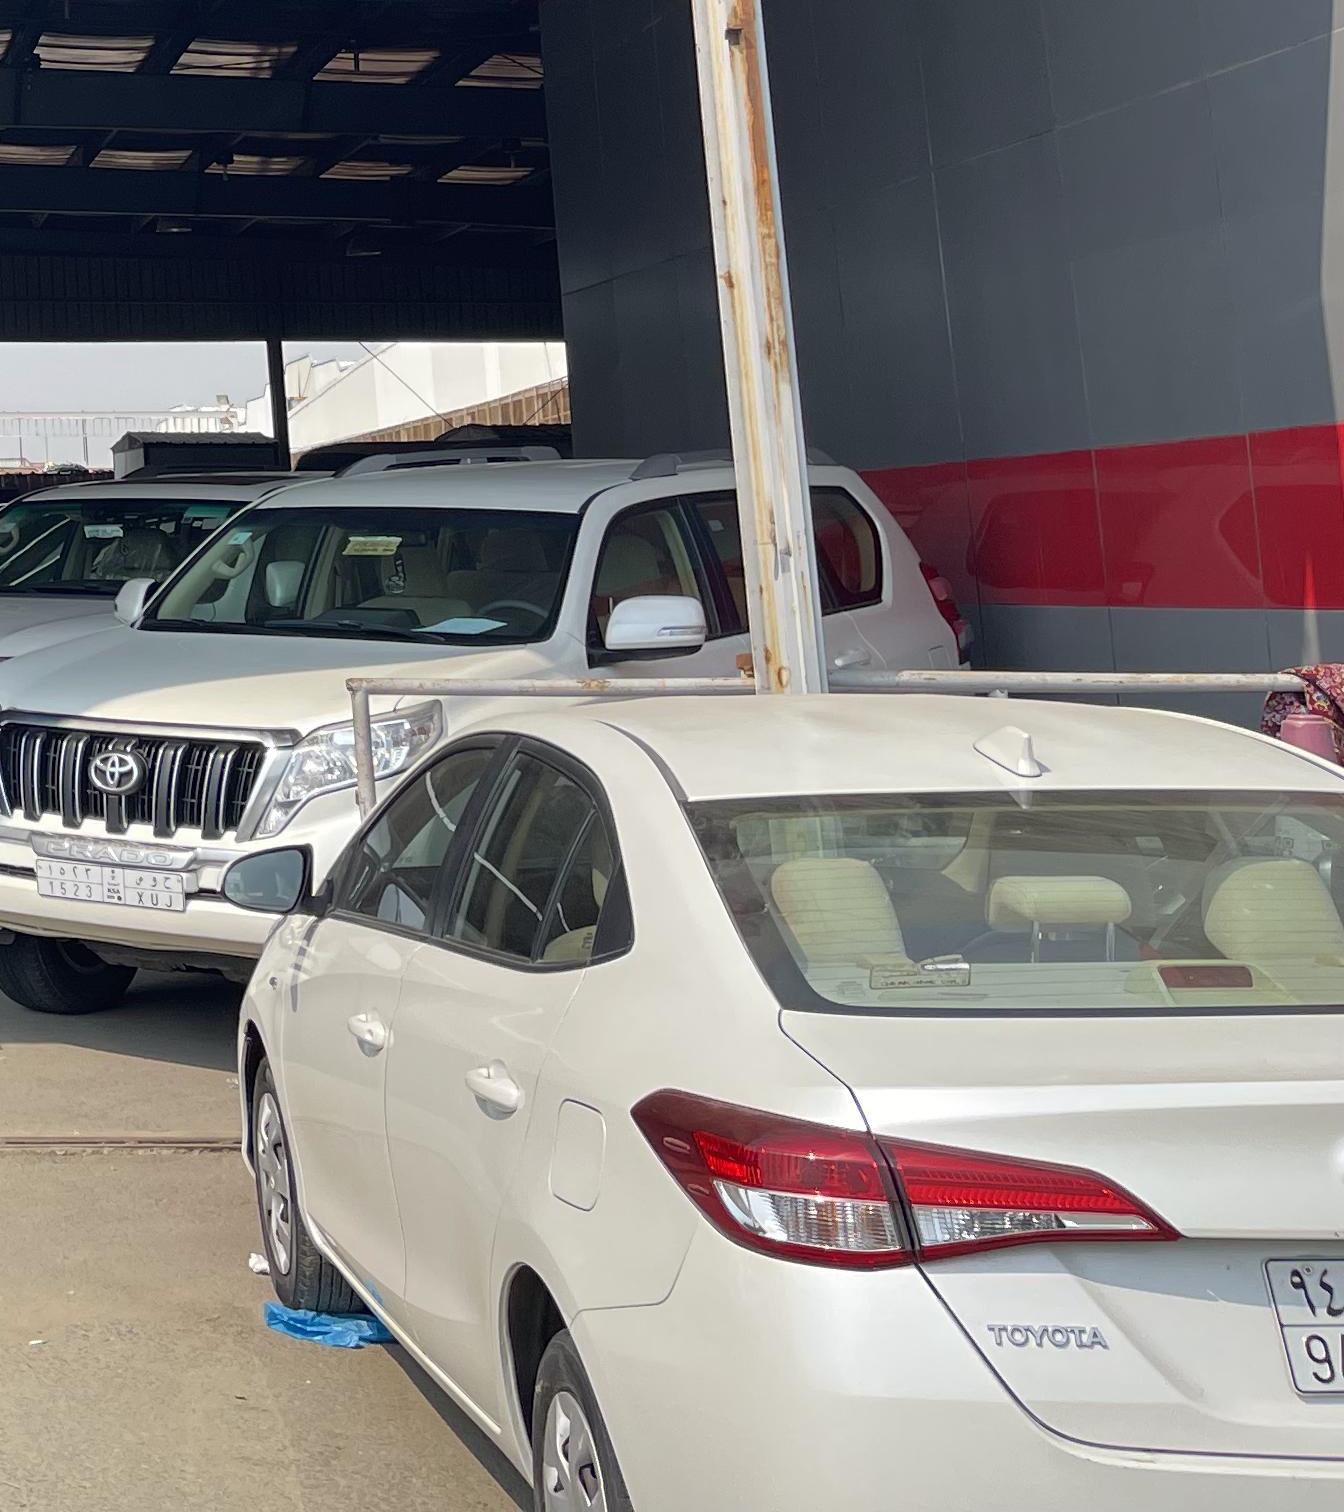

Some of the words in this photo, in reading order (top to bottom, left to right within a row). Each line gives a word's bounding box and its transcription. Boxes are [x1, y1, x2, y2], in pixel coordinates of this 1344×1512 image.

[47, 841, 173, 866] PRADO
[49, 881, 93, 899] 1523
[137, 891, 173, 908] XUJ
[987, 1324, 1110, 1350] TOYOTA
[1305, 1333, 1344, 1384] 9
